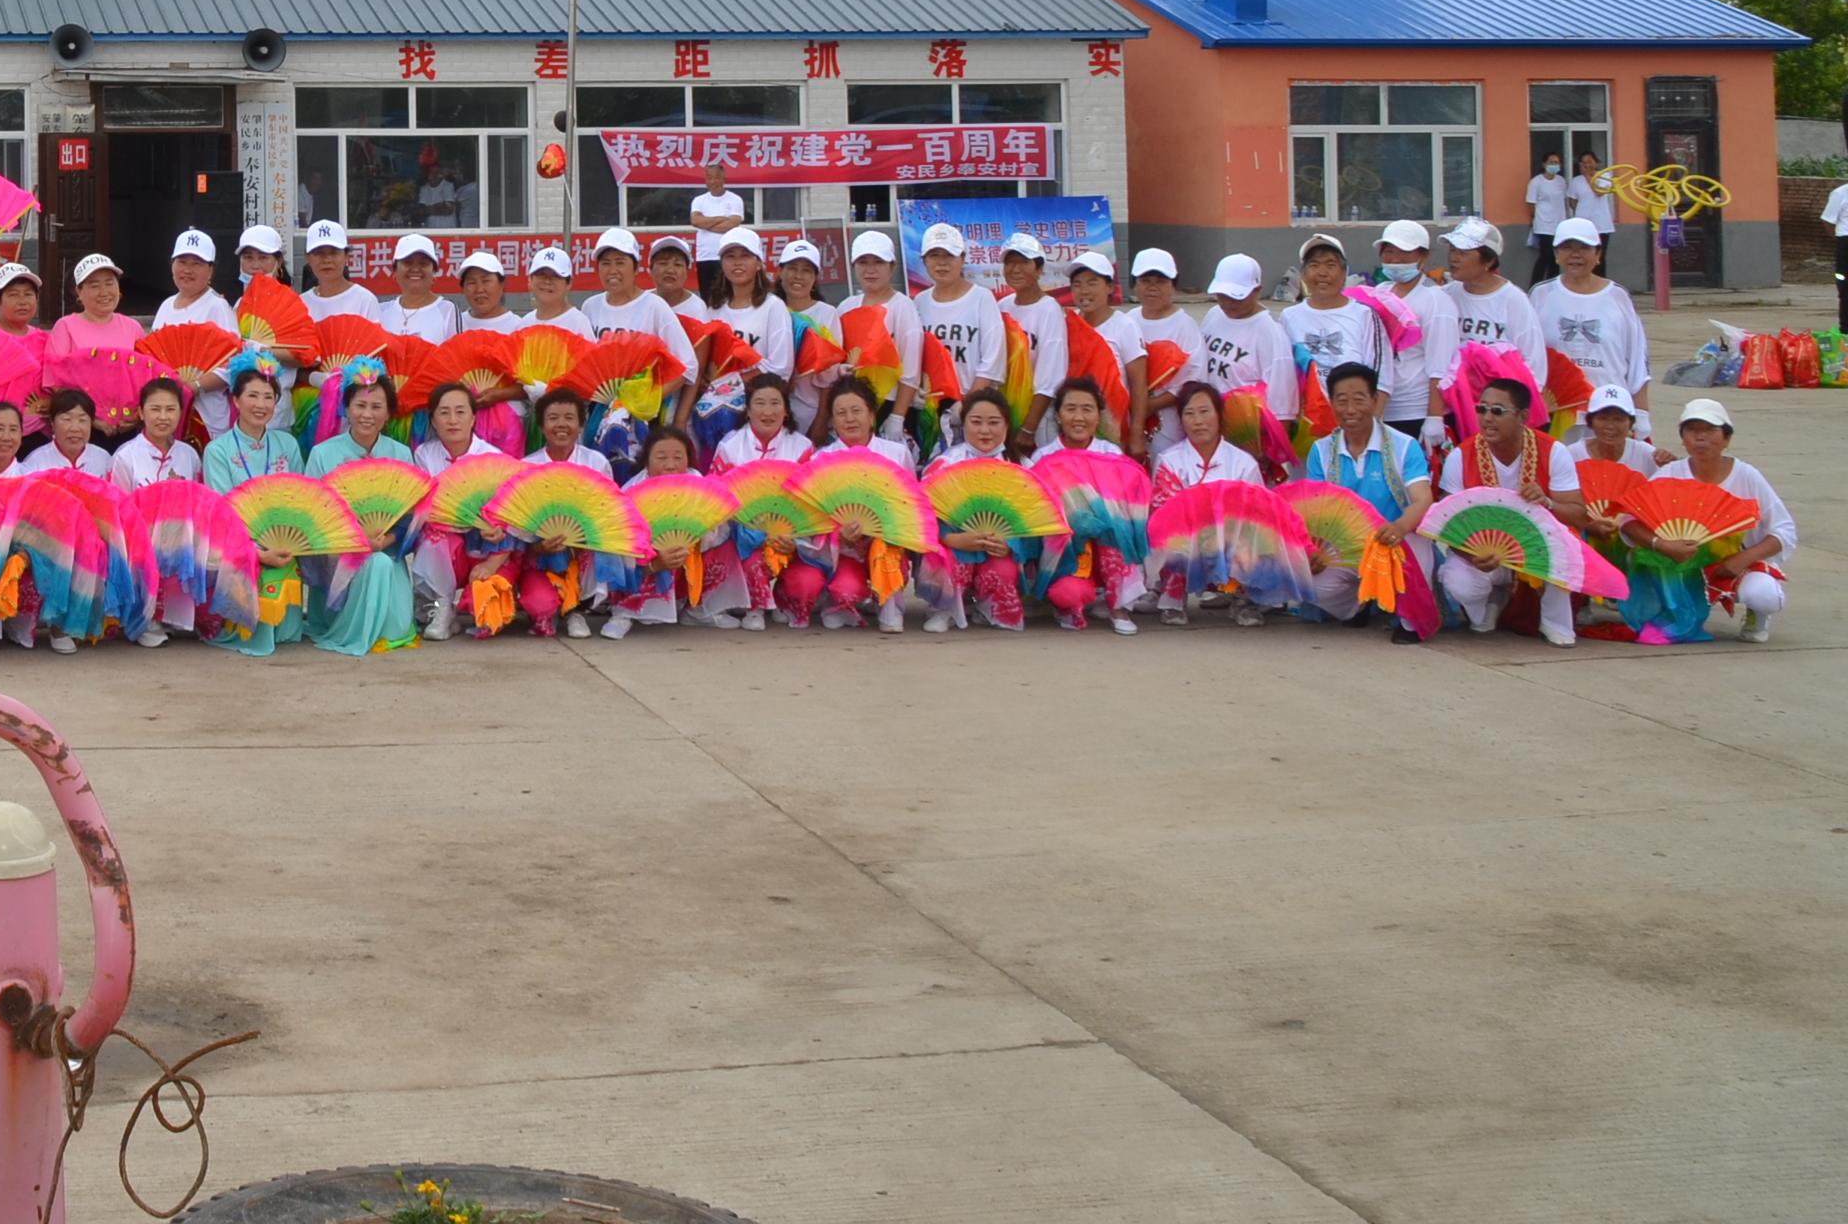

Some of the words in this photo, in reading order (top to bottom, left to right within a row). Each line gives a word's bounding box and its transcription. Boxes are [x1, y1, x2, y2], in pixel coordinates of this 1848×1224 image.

[62, 142, 86, 166] 出口
[611, 129, 1039, 168] 热烈庆祝建党一百周年
[895, 162, 1039, 179] 安民乡奉安村宣
